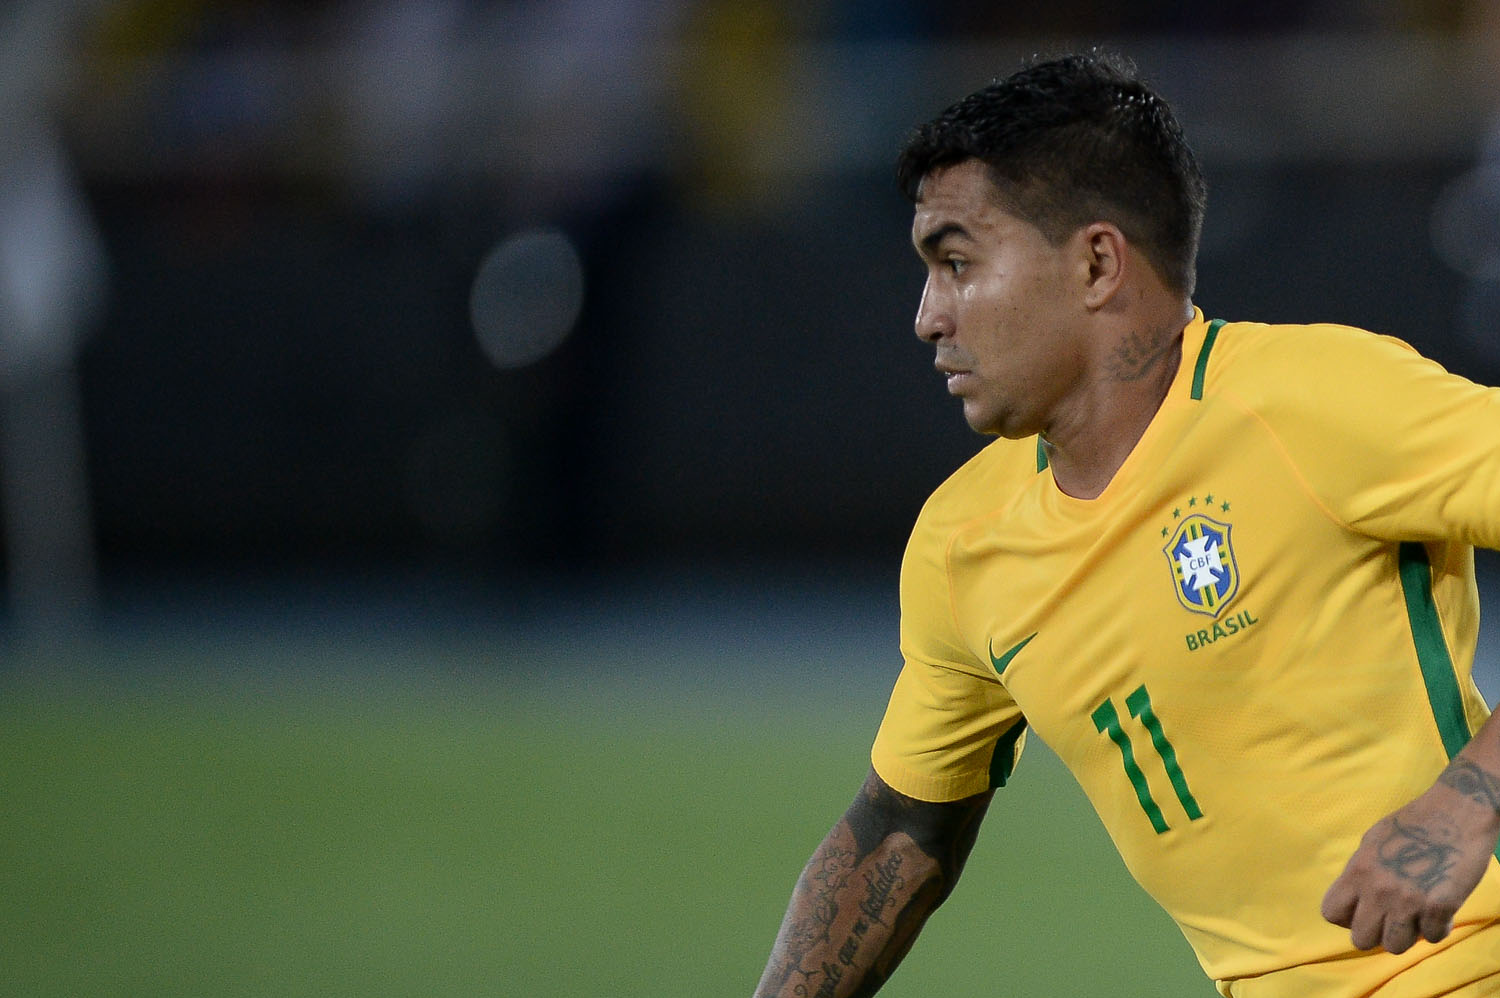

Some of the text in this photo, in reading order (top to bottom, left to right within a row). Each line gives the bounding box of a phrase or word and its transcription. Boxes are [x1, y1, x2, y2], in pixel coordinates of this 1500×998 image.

[1189, 553, 1212, 571] CBF
[1185, 610, 1259, 651] BRASIL
[1091, 683, 1204, 835] 11
